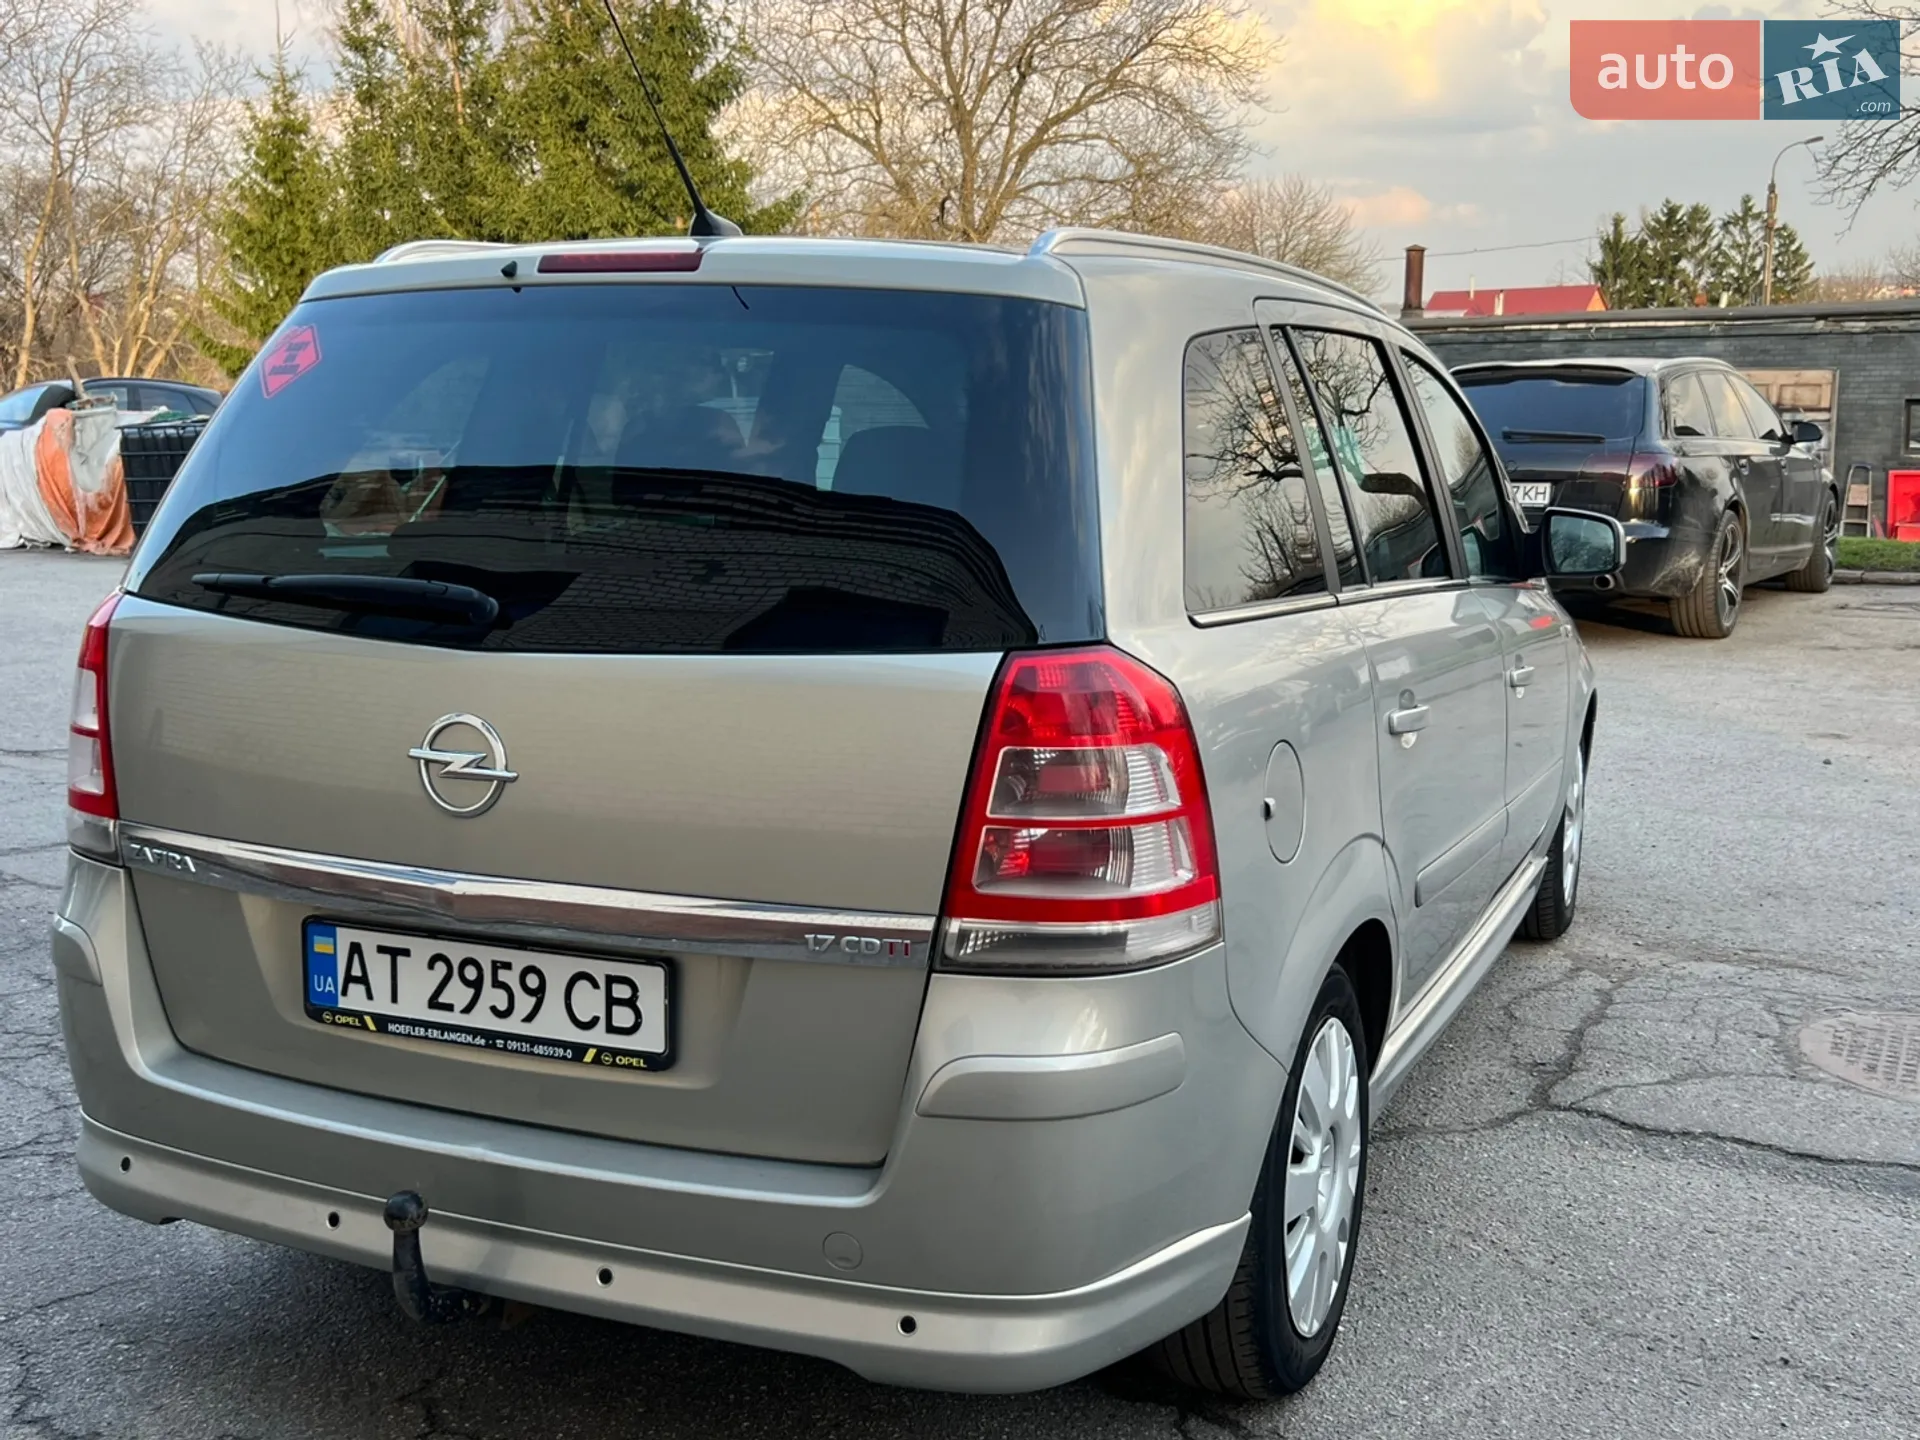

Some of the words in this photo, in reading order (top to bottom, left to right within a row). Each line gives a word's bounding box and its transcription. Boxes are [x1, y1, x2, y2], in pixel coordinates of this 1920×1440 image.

[840, 935, 911, 958] CDTI
[313, 974, 336, 994] UA
[341, 941, 411, 1004] AT
[427, 953, 547, 1023] 2959
[563, 970, 644, 1037] CB
[335, 1016, 361, 1027] OPEL
[387, 1022, 487, 1047] HOEFLER-ERLANGEN.de
[615, 1056, 648, 1068] OPEL
